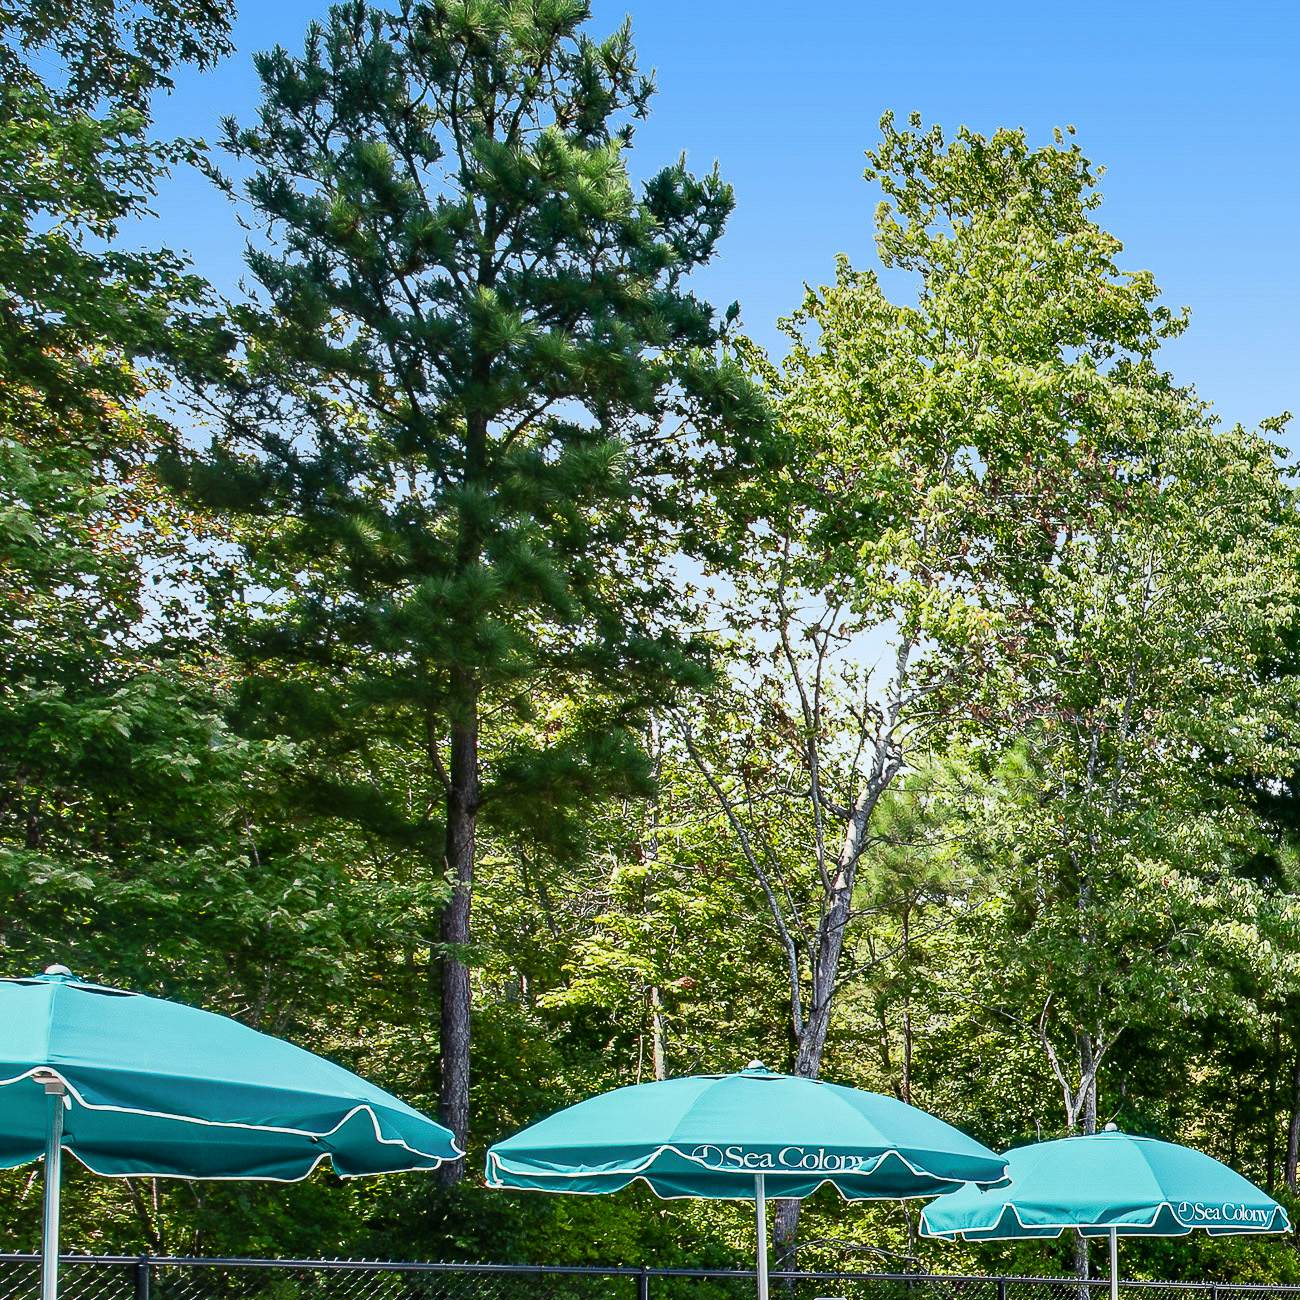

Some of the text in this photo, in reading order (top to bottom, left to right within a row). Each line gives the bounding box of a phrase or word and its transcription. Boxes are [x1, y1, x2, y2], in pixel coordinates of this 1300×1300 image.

[725, 1146, 775, 1168] Sea
[1195, 1203, 1271, 1226] Sea Colony
